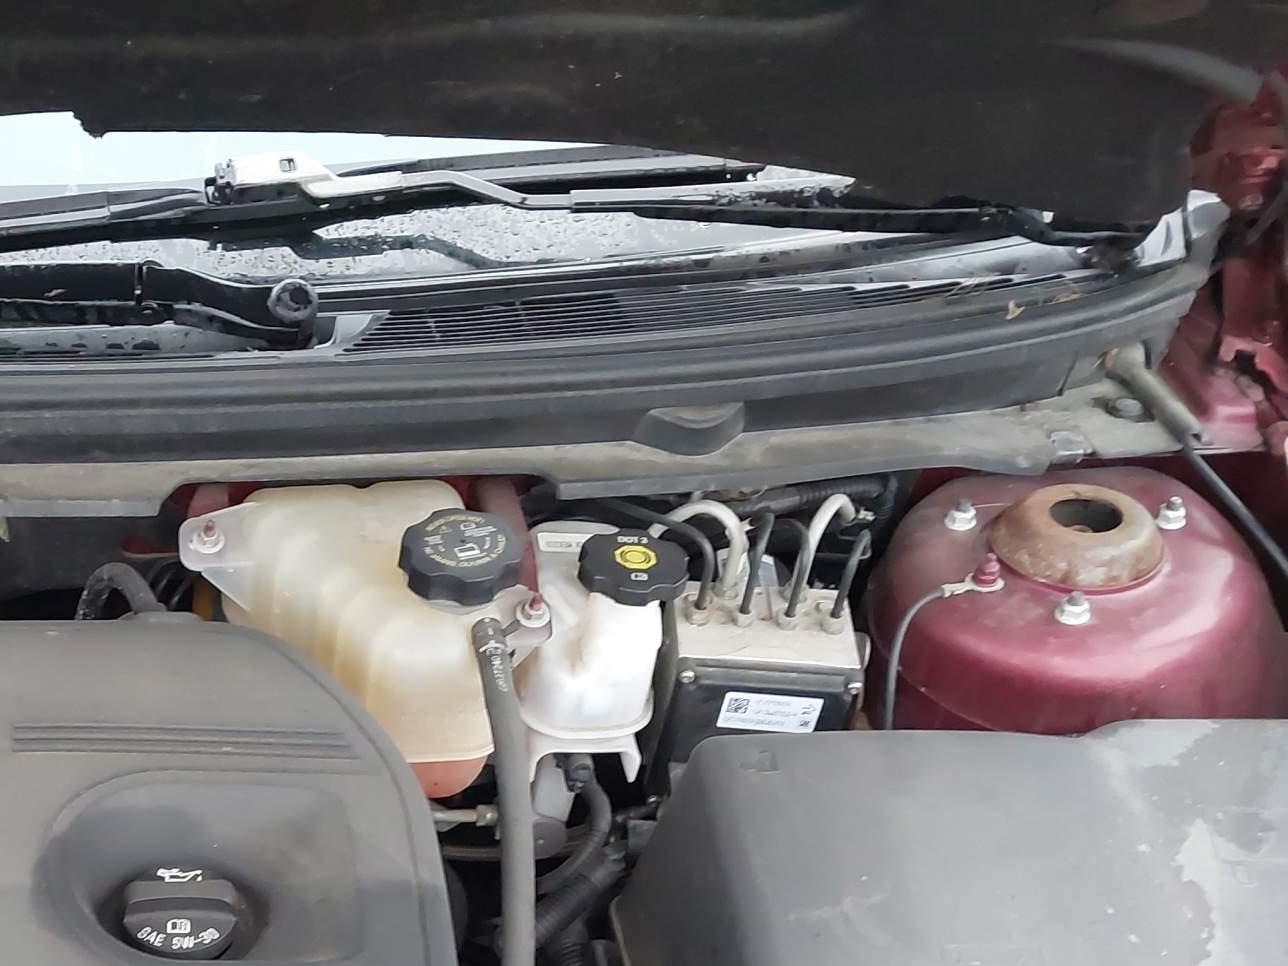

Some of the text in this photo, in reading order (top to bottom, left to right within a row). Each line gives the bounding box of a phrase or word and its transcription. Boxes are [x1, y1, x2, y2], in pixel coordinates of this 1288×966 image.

[616, 535, 638, 544] DOT
[136, 926, 220, 950] SAE 5W-30
